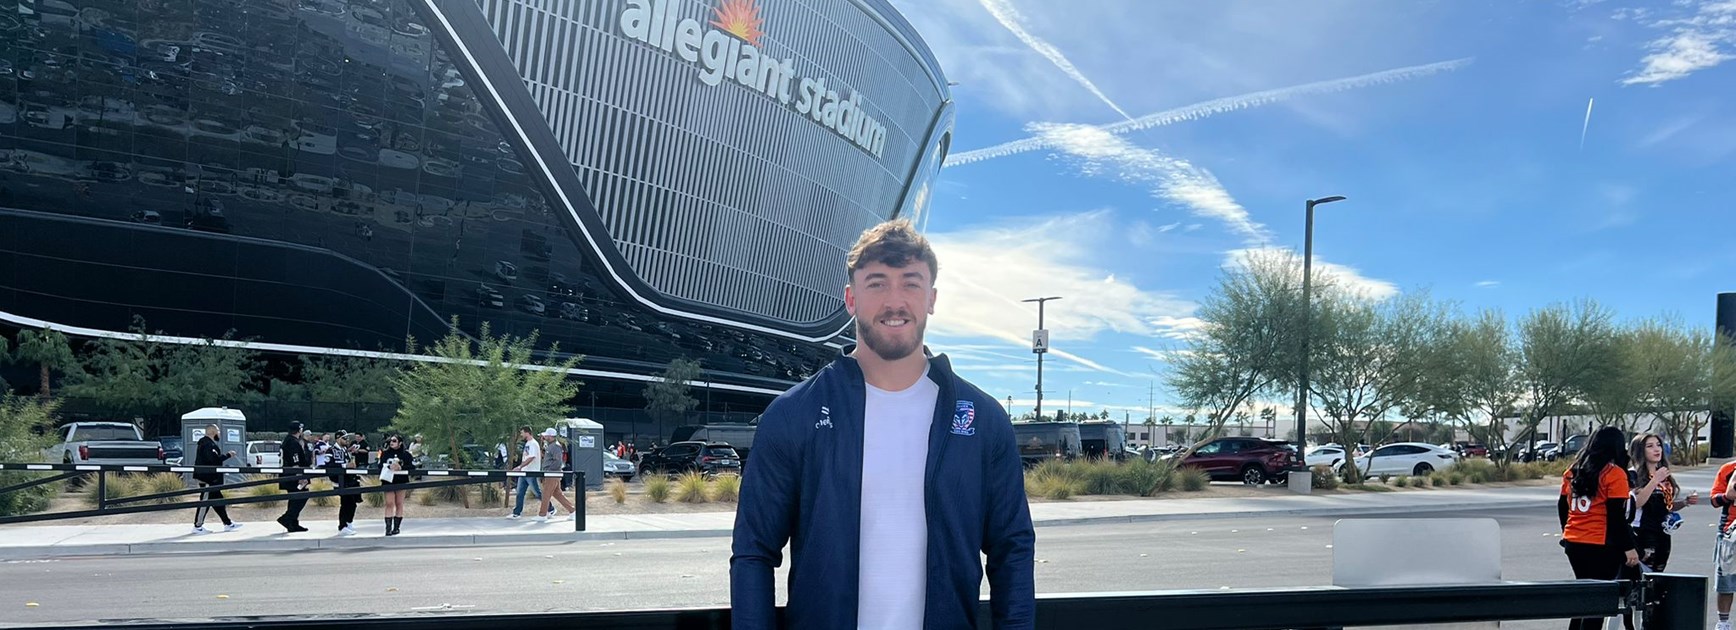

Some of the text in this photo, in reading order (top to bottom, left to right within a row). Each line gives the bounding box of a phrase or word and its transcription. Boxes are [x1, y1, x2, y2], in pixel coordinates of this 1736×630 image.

[620, 0, 887, 159] allegiant stadium
[1035, 338, 1043, 348] A
